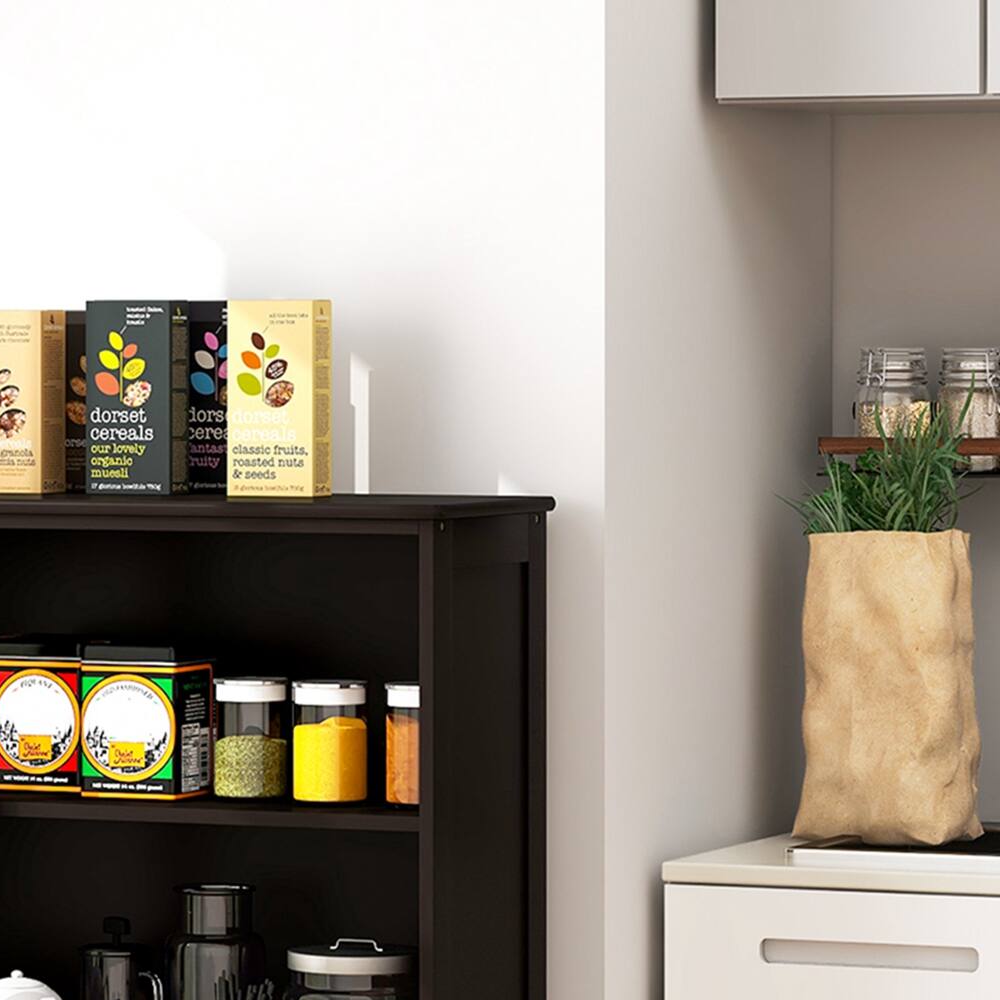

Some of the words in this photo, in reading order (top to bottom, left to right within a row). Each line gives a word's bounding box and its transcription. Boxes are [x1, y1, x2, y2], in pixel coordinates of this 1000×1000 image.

[90, 407, 147, 423] dorset
[232, 408, 288, 424] dorset
[90, 425, 154, 441] cereals
[232, 424, 296, 441] cereals
[0, 448, 34, 458] granola
[90, 444, 111, 454] our
[112, 443, 146, 456] lovely
[232, 444, 271, 455] classic
[273, 444, 309, 456] fruits,
[90, 456, 133, 468] organic
[232, 457, 275, 468] roasted
[278, 458, 304, 468] nuts
[90, 468, 129, 478] muesli
[232, 468, 243, 480] &
[244, 470, 278, 480] seeds
